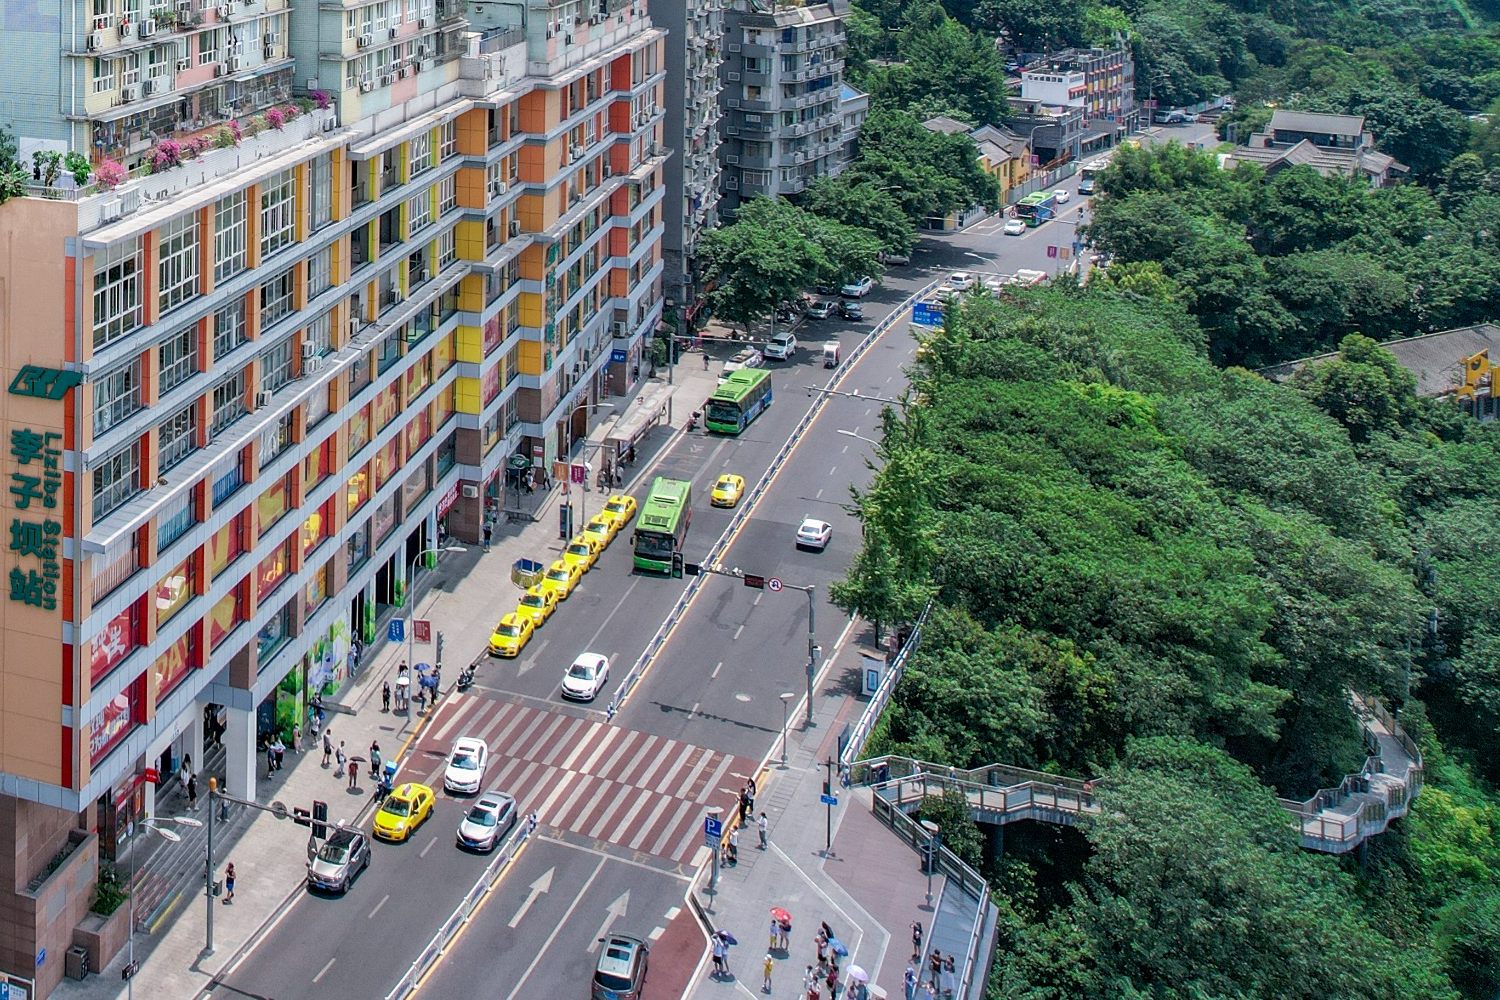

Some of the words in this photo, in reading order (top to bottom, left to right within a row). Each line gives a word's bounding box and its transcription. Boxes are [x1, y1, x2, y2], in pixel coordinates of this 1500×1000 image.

[43, 431, 62, 509] Liziba
[9, 428, 43, 607] 李子坝站
[42, 518, 62, 611] Station
[548, 829, 687, 876] 礼让行人
[707, 819, 715, 833] P
[1, 983, 8, 995] P
